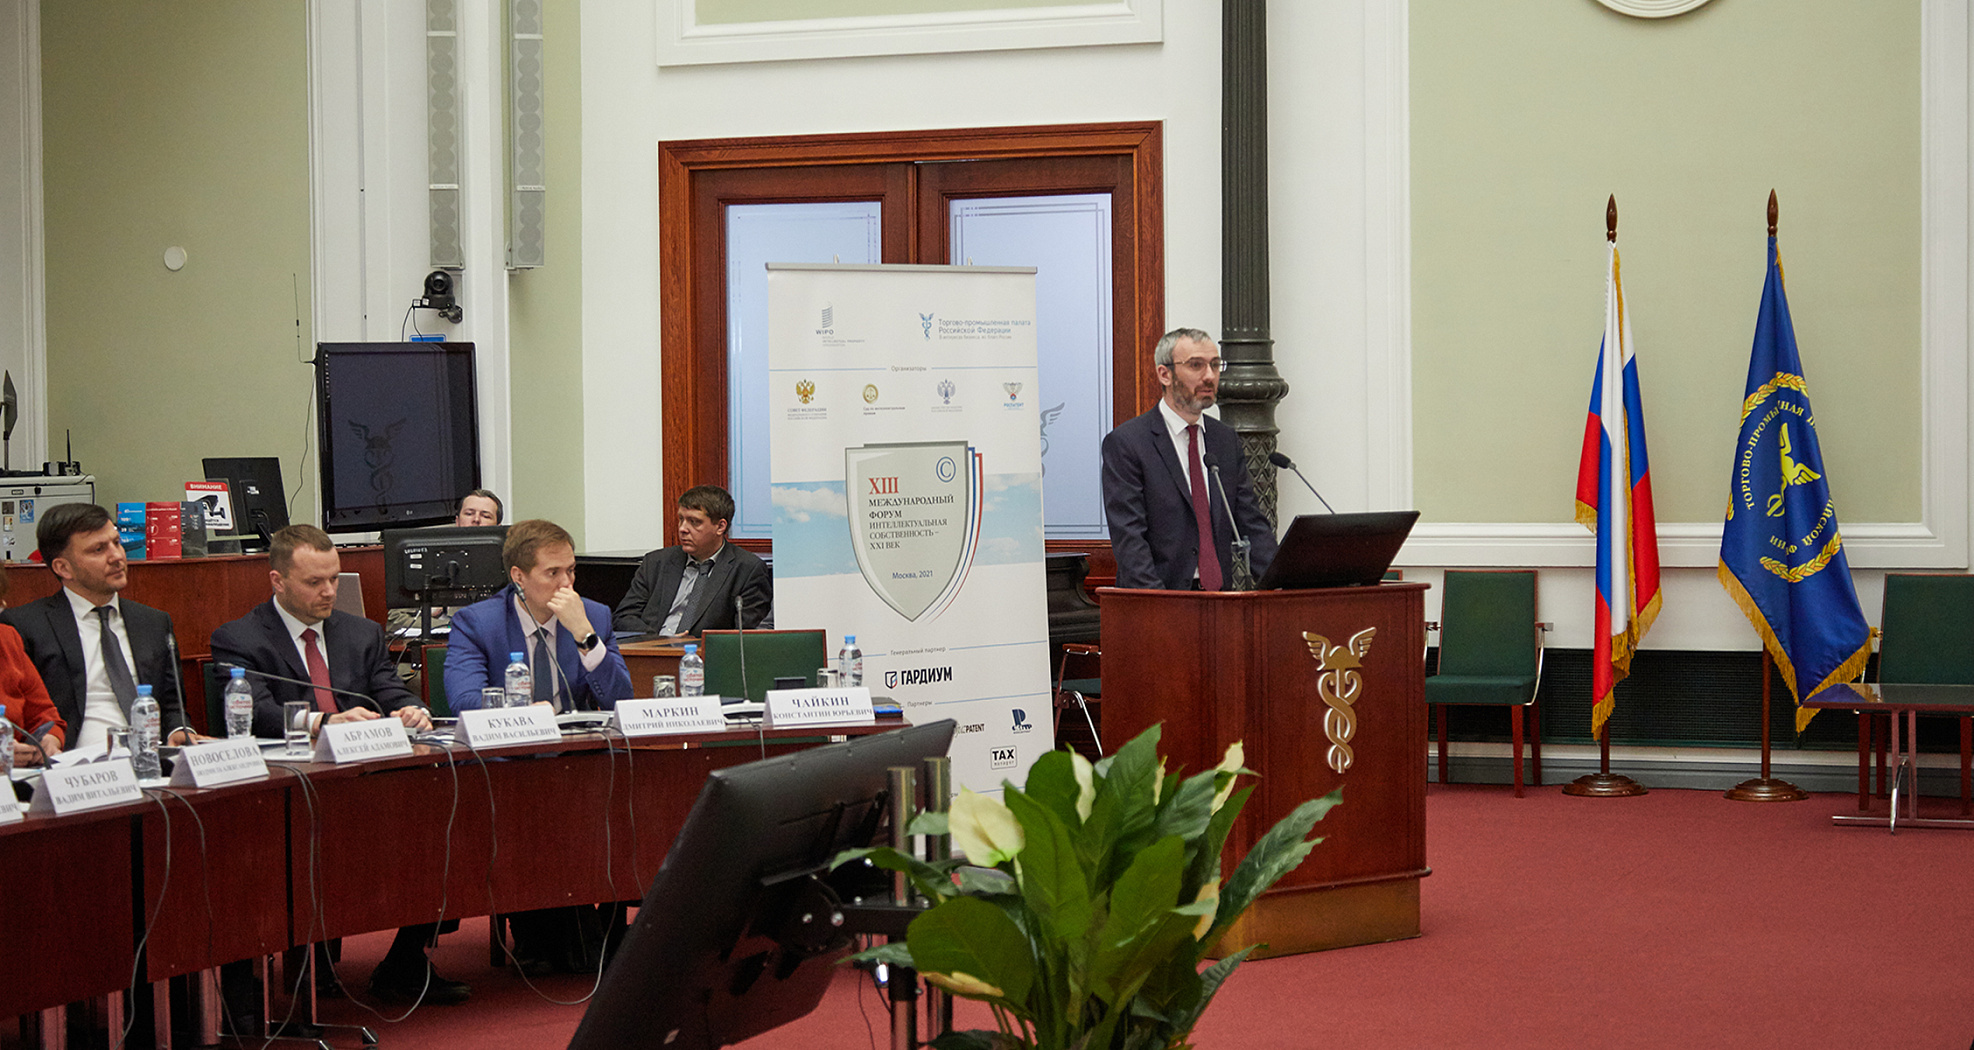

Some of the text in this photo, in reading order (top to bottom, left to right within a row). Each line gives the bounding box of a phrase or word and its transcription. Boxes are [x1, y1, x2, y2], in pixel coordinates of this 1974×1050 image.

[868, 476, 899, 494] XIII
[868, 494, 954, 507] МЕЖДУНАРОДНЫЙ
[869, 510, 902, 519] ФОРУМ
[869, 518, 948, 530] ИНТЕЛЛЕКТУАЛЬНАЯ
[870, 529, 934, 540] СОБСТВЕННОСТЬ
[886, 540, 900, 549] ВЕК
[892, 570, 934, 580] Москва, 2021
[901, 666, 952, 685] ГАРДИУМ
[792, 696, 849, 708] ЧАЙКИН
[642, 706, 698, 718] МАРКИН
[774, 710, 830, 720] КОНСТАНТИН
[488, 716, 534, 728] КУКАВА
[624, 718, 723, 730] ДМИТРИЙ НИКОЛАЕВИЧ
[344, 727, 392, 742] АБРАМОВ
[472, 728, 556, 742] ВАДИМ ВАСИЛЬЕВИЧ
[336, 740, 408, 756] АЛЕКСЕЙ АДАМОВИЧ
[190, 746, 259, 766] НОВОСЕЛОВА
[992, 749, 1014, 760] TAX
[64, 770, 118, 788] ЧУБАРОВ
[55, 784, 138, 804] ВАДИМ ВИТАЛЬЕВИЧ
